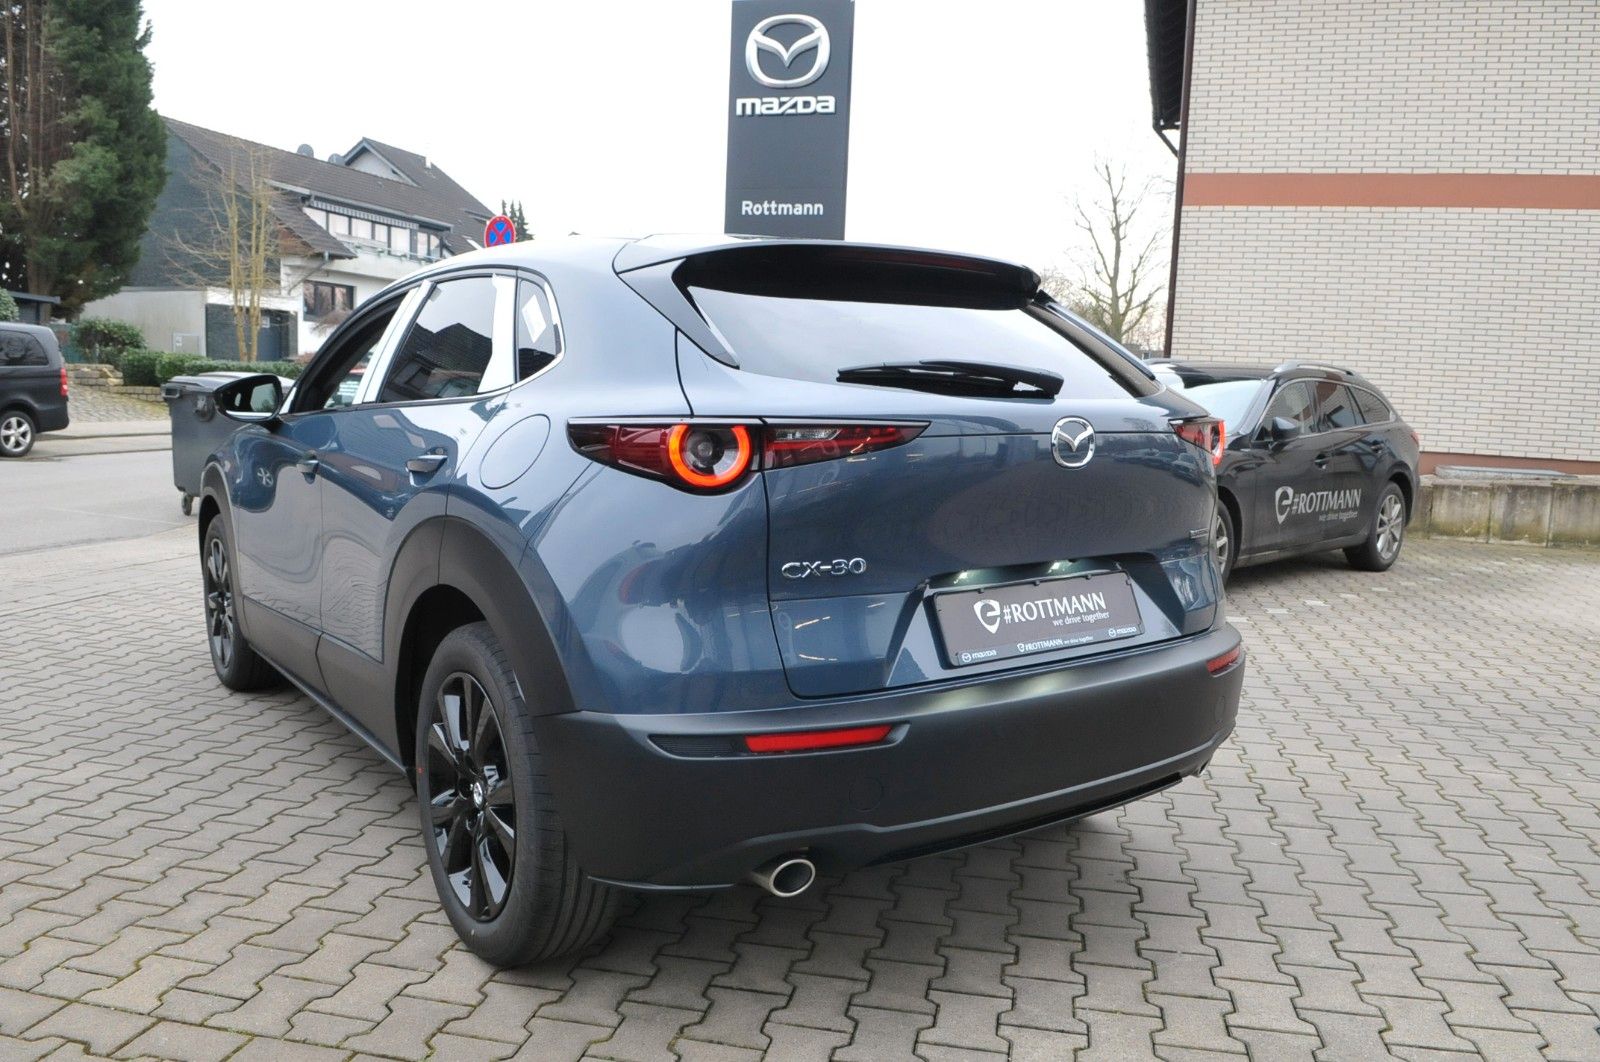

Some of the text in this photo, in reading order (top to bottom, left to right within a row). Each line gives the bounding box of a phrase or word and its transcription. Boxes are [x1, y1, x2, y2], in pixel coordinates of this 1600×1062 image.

[741, 200, 824, 216] Rottmann
[781, 557, 867, 578] CX-30
[1064, 615, 1082, 625] drive
[1082, 611, 1110, 623] together
